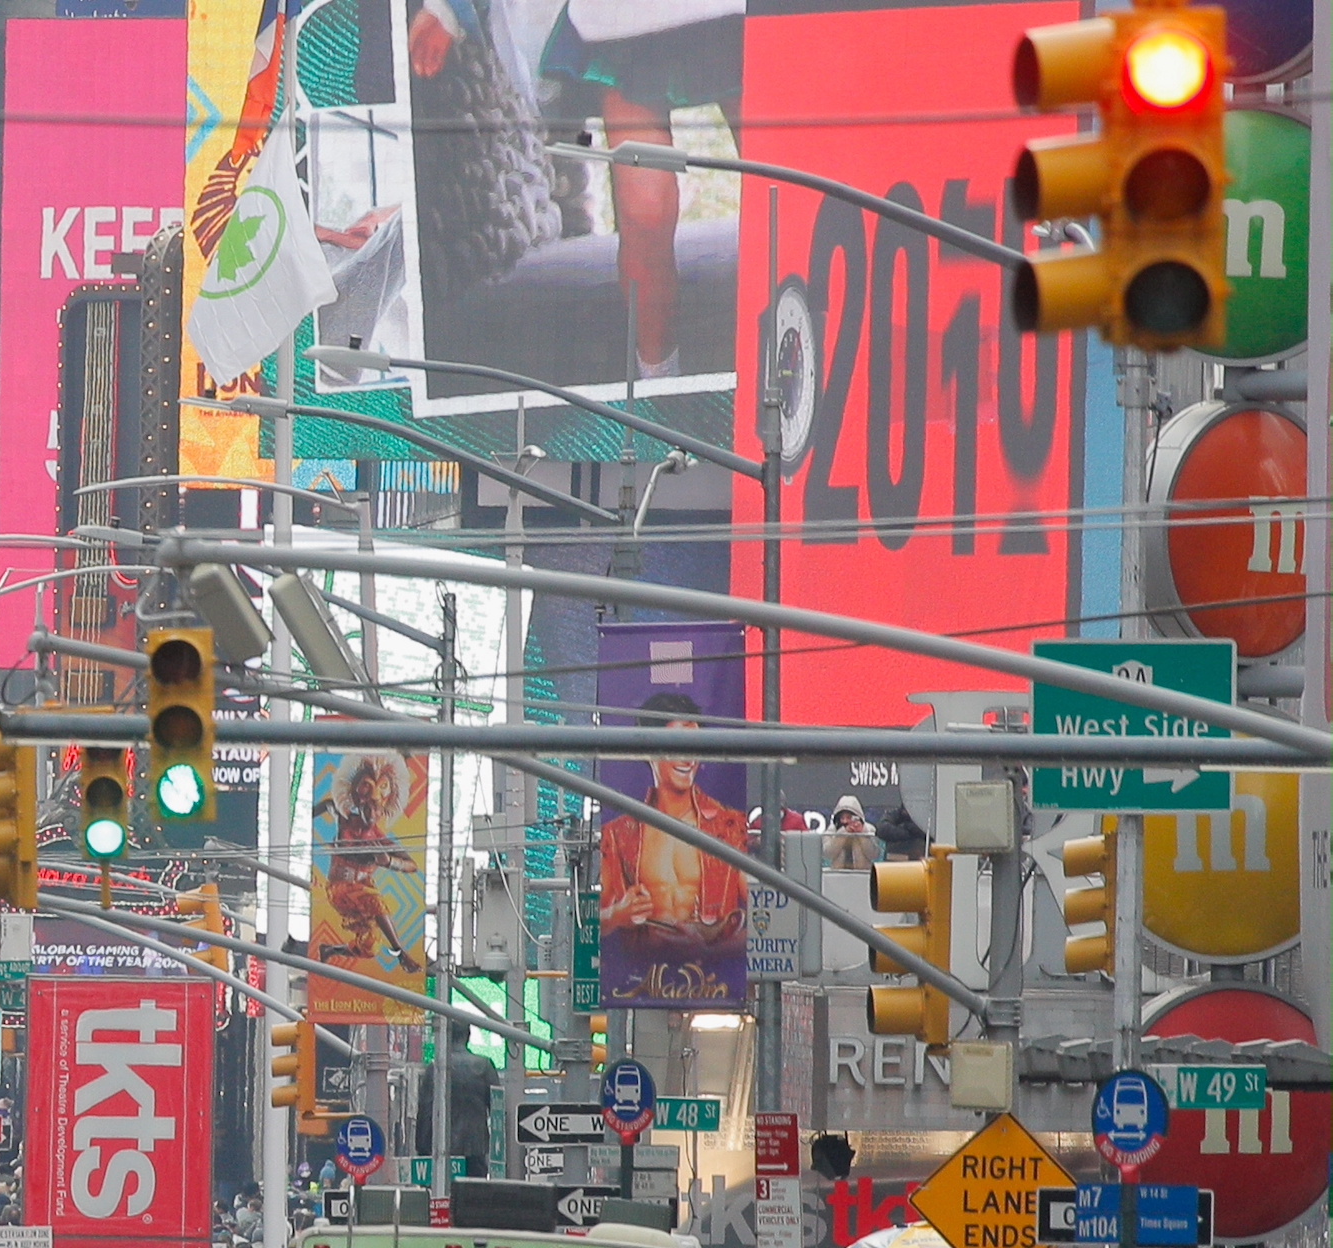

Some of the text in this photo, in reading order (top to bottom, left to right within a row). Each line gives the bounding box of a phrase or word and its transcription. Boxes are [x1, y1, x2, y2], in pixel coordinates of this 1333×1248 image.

[1055, 712, 1210, 738] West Side
[850, 761, 889, 787] SWISS
[1061, 767, 1125, 796] Hwy
[86, 944, 139, 957] GAMING
[88, 956, 113, 968] THE
[117, 957, 153, 968] YEAR
[612, 962, 729, 1000] Aladdin
[330, 999, 352, 1013] LION
[59, 1019, 69, 1057] service
[59, 1059, 69, 1071] of
[58, 1072, 70, 1115] Theatre
[1179, 1072, 1260, 1104] W 49 St
[70, 999, 183, 1219] tkts
[655, 1103, 717, 1127] W 48 St
[534, 1116, 571, 1132] ONE
[615, 1112, 651, 1131] STANDING
[765, 1115, 792, 1126] STANDING
[56, 1117, 69, 1188] Development
[528, 1155, 553, 1167] ONE
[1100, 1138, 1161, 1165] NO STANDING
[349, 1157, 381, 1175] STANDING
[962, 1155, 1044, 1181] RIGHT
[759, 1179, 768, 1198] 3
[1079, 1186, 1102, 1208] M7
[56, 1189, 67, 1217] Fund
[567, 1198, 602, 1215] ONE
[758, 1205, 794, 1215] COMMERCIAL
[963, 1190, 1037, 1215] LANE
[758, 1215, 800, 1226] VEHICLES ONLY
[1079, 1216, 1118, 1238] M104
[1140, 1217, 1188, 1231] Times Square
